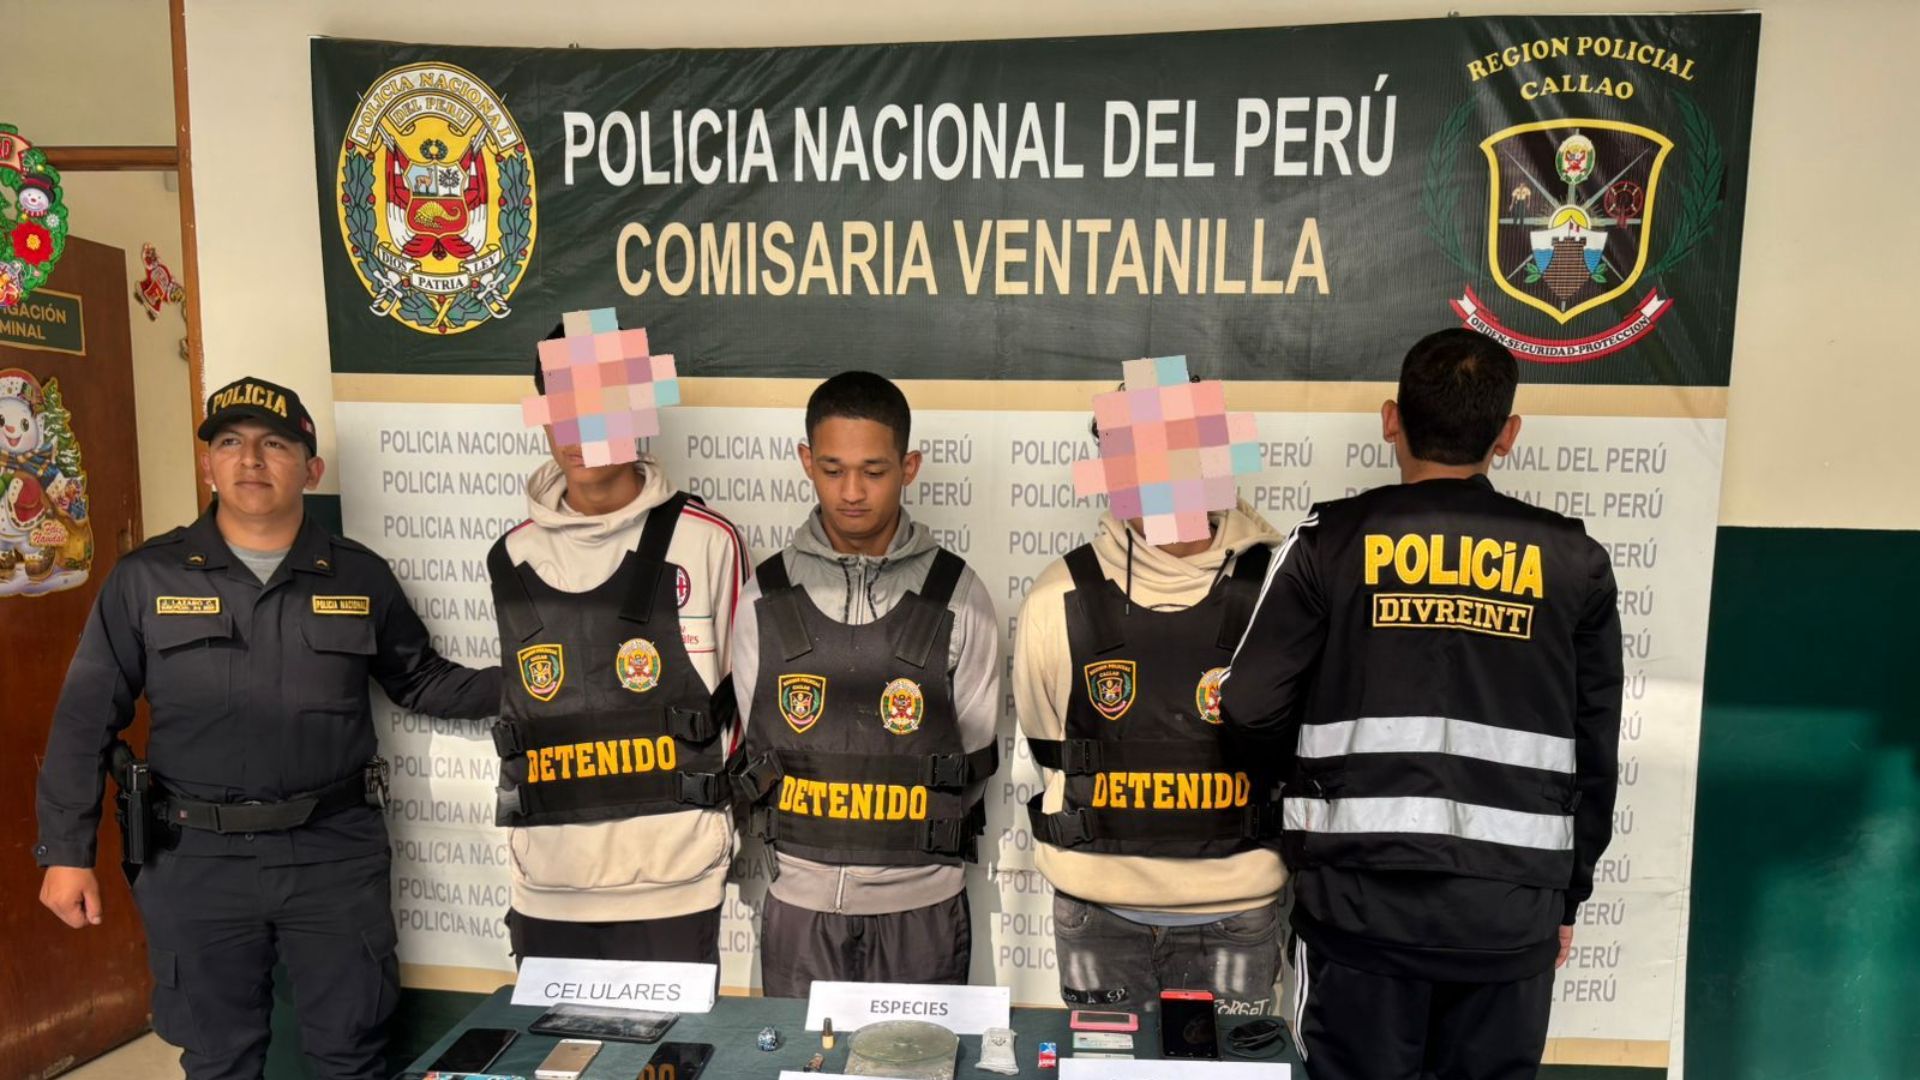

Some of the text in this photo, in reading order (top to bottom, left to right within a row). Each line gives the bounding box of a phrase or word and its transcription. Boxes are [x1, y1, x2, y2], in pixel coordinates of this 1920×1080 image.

[1466, 36, 1695, 82] REGION POLICIAL
[1520, 74, 1634, 101] CALLAO
[356, 73, 513, 142] POLICIA NACIONAL
[563, 73, 1397, 186] POLICIA NACIONAL DEL PERÚ
[382, 251, 408, 271] DIOS
[474, 253, 497, 272] LEY
[616, 217, 1330, 296] COMISARIA VENTANILLA
[418, 276, 464, 290] PATRIA
[3, 302, 67, 325] IGACIÓN
[0, 319, 47, 340] MINAL
[212, 383, 288, 418] POLICIA
[380, 430, 553, 456] POLICIA NACIONAL
[687, 435, 765, 460] POLICIA
[919, 433, 972, 464] PERÚ
[1011, 440, 1090, 465] POLICIA
[1346, 443, 1396, 469] POLI
[1557, 446, 1599, 472] DEL
[1606, 442, 1667, 474] PERÚ
[383, 470, 529, 496] POLICIA NACION
[689, 477, 766, 502] POLICIA
[771, 479, 817, 503] NACI
[919, 476, 972, 506] PERÚ
[1010, 483, 1090, 508] POLICIA
[1254, 480, 1311, 511] PERÚ
[1555, 491, 1596, 517] DEL
[1603, 487, 1664, 519] PERÚ
[384, 515, 456, 539] POLICIA
[931, 524, 971, 553] ERÚ
[1009, 531, 1086, 555] POLICIA
[414, 597, 461, 620] LICIA
[1379, 598, 1526, 633] DIVREINT
[1622, 627, 1651, 659] RÚ
[391, 711, 464, 736] POLICIA
[394, 755, 465, 779] POLICIA
[526, 735, 677, 783] DETENIDO
[778, 775, 928, 821] DETENIDO
[1091, 771, 1252, 809] DETENIDO
[392, 799, 465, 824] POLICIA
[394, 840, 512, 866] POLICIA NACI
[398, 877, 512, 907] POLICIA NACI
[1001, 872, 1054, 894] POLIC
[399, 909, 468, 935] POLICIA
[1000, 913, 1055, 936] POLIC
[999, 946, 1056, 970] POLIC
[1566, 940, 1621, 969] PERÚ
[543, 982, 682, 1002] CELULARES
[1562, 973, 1617, 1002] PERÚ
[870, 1000, 949, 1016] ESPECIES
